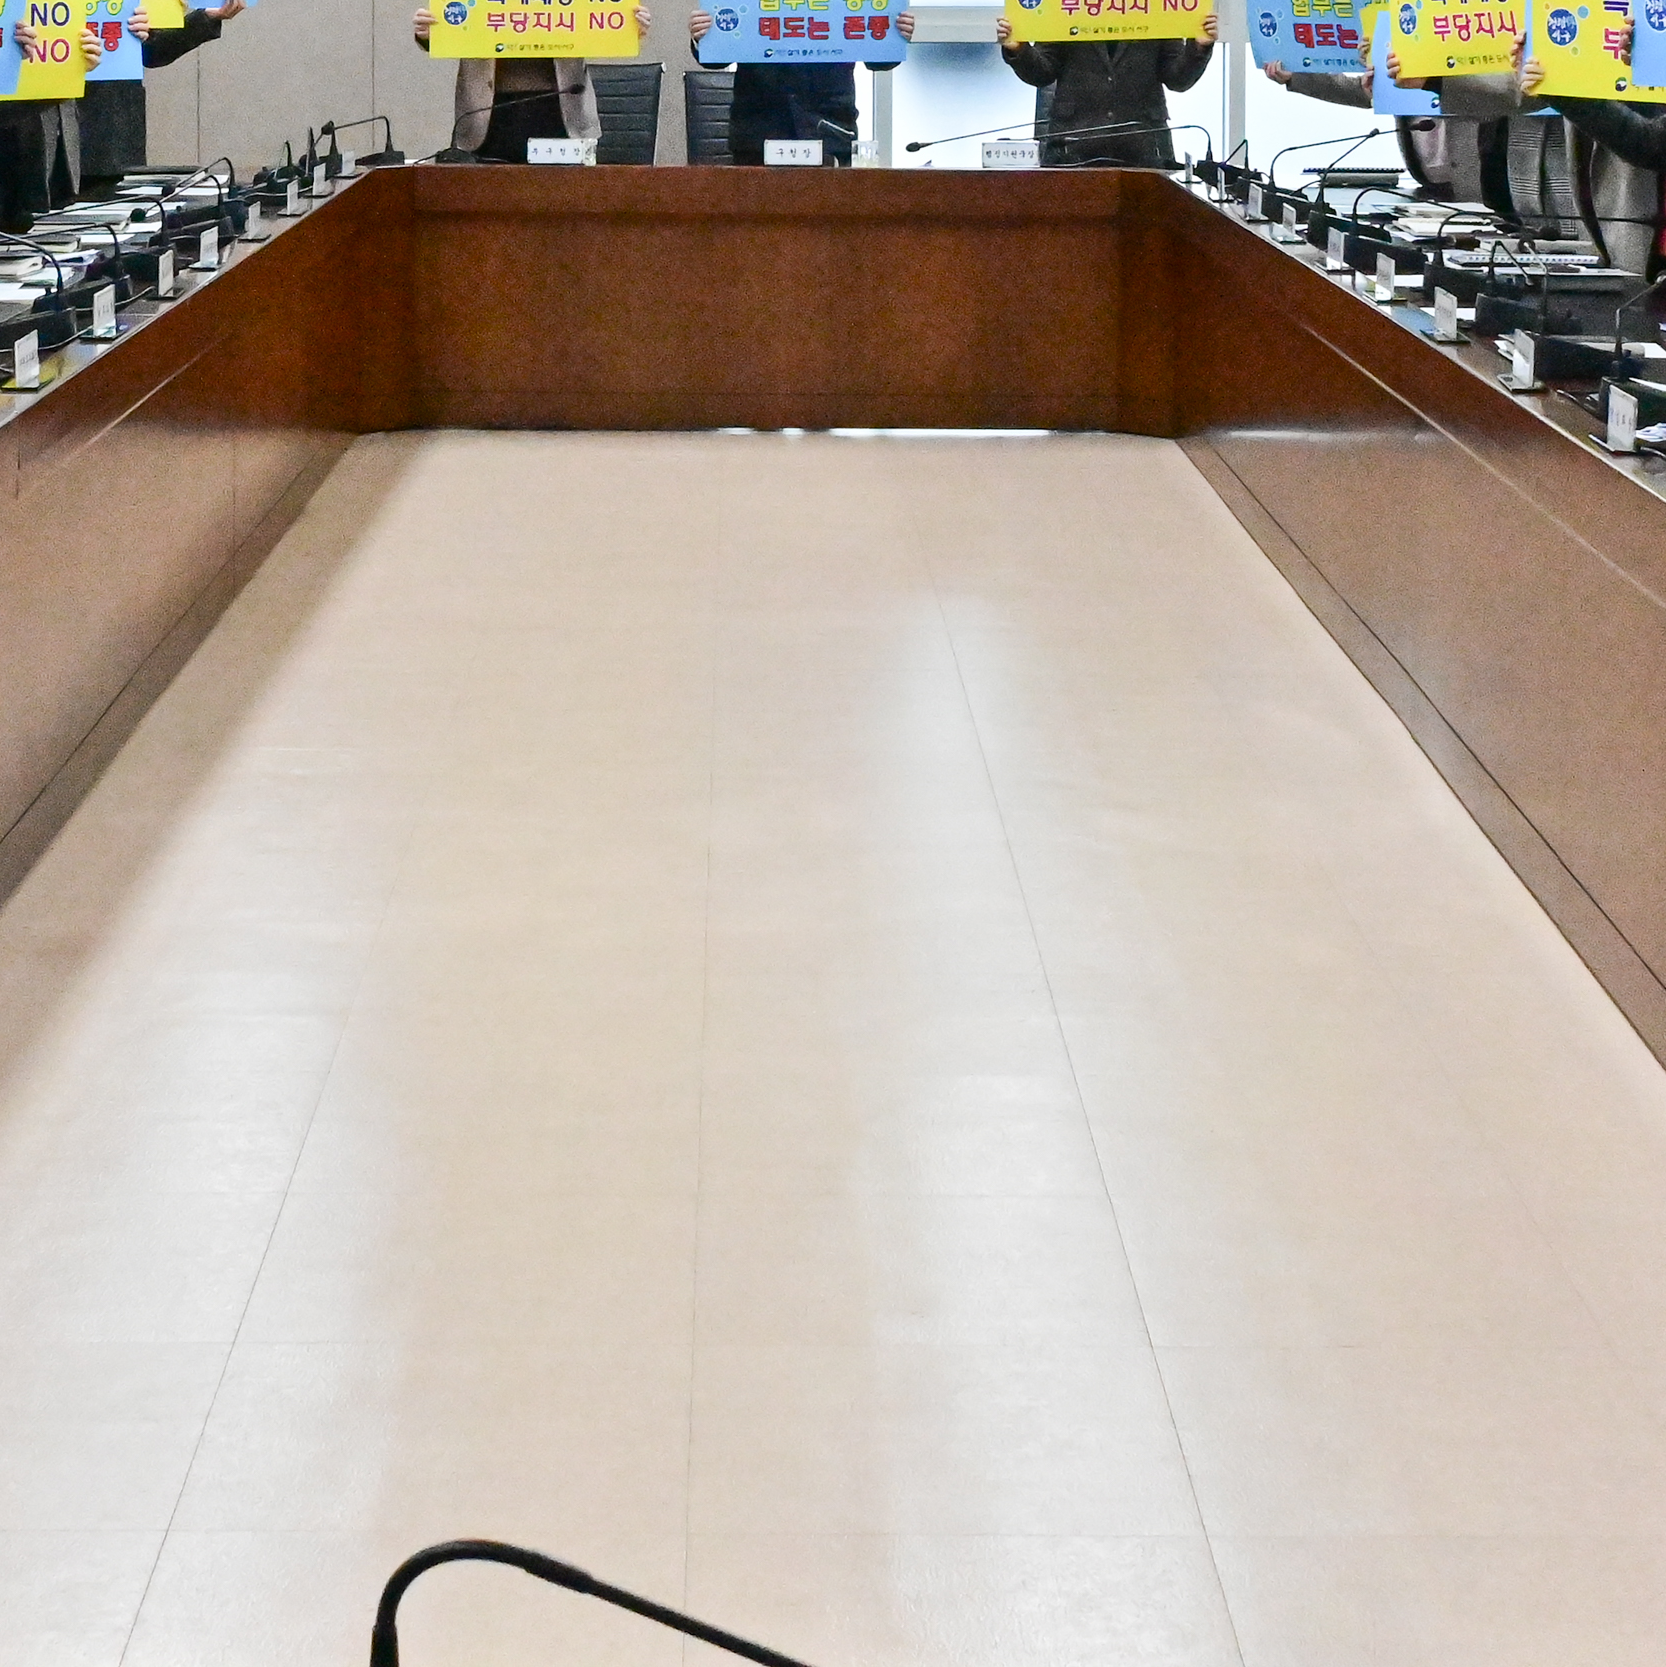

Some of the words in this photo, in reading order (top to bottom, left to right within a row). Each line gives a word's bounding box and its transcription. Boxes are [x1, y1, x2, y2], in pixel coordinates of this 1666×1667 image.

[30, 2, 70, 27] NO
[486, 12, 576, 33] 부당지시
[589, 11, 625, 30] NO
[1433, 10, 1518, 42] 부당지시
[843, 16, 890, 41] 존중
[30, 39, 71, 64] NO
